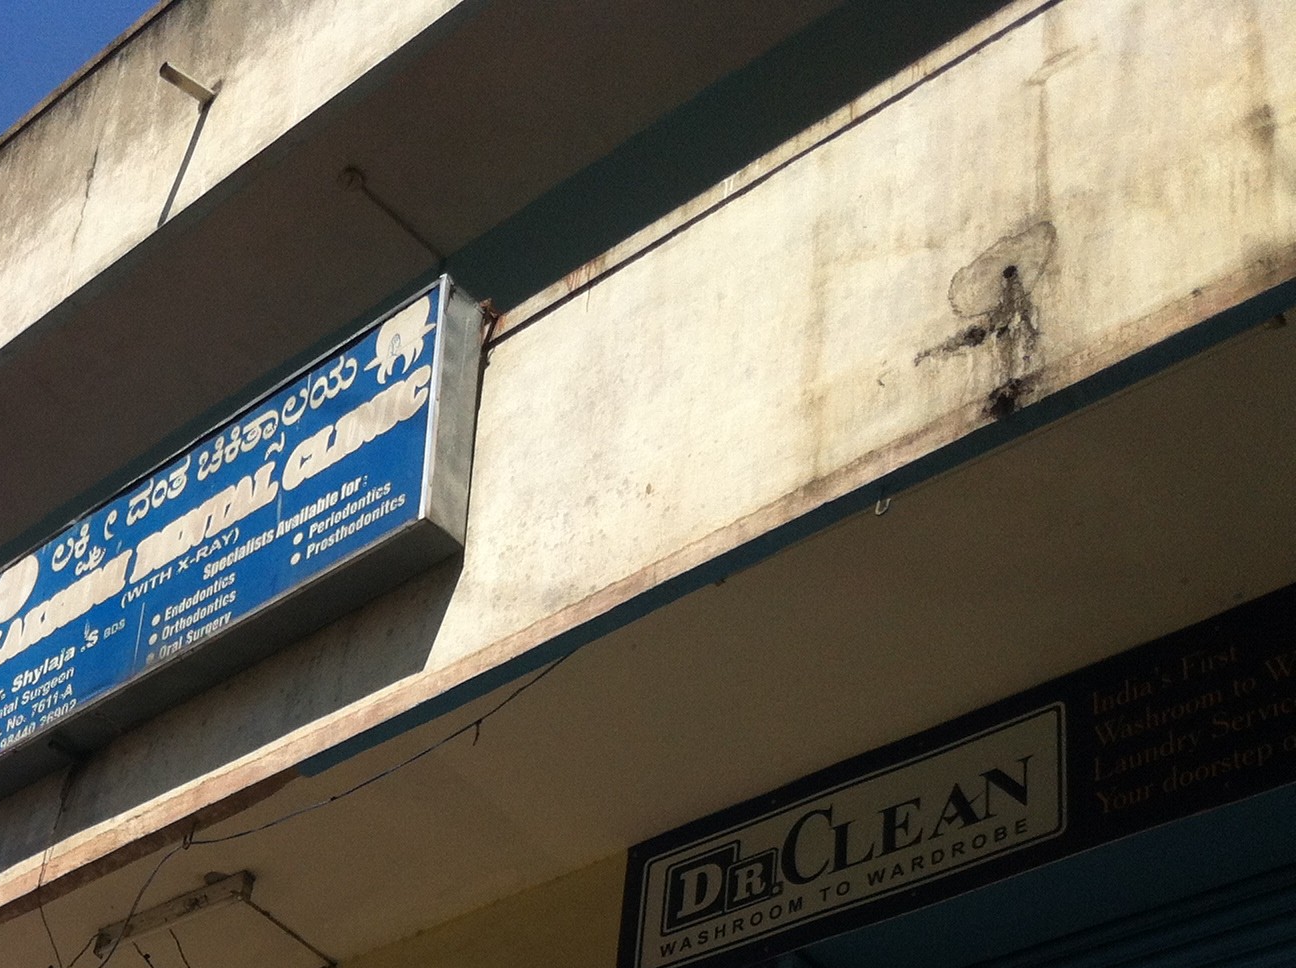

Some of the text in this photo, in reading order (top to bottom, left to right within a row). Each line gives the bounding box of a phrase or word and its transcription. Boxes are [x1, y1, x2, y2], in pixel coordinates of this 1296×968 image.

[308, 481, 391, 538] Periodontics
[203, 529, 275, 580] Specialists
[275, 490, 339, 538] Available
[121, 566, 172, 609] (WITH
[165, 572, 236, 622] Endodontics
[161, 590, 236, 640] Orthodontics
[11, 647, 75, 692] Shylaja
[21, 667, 75, 706] Surgeon
[1094, 689, 1224, 747] Washroom
[1161, 744, 1274, 793] doorstep
[661, 817, 1029, 958] WASHROOM TO WARDROBE
